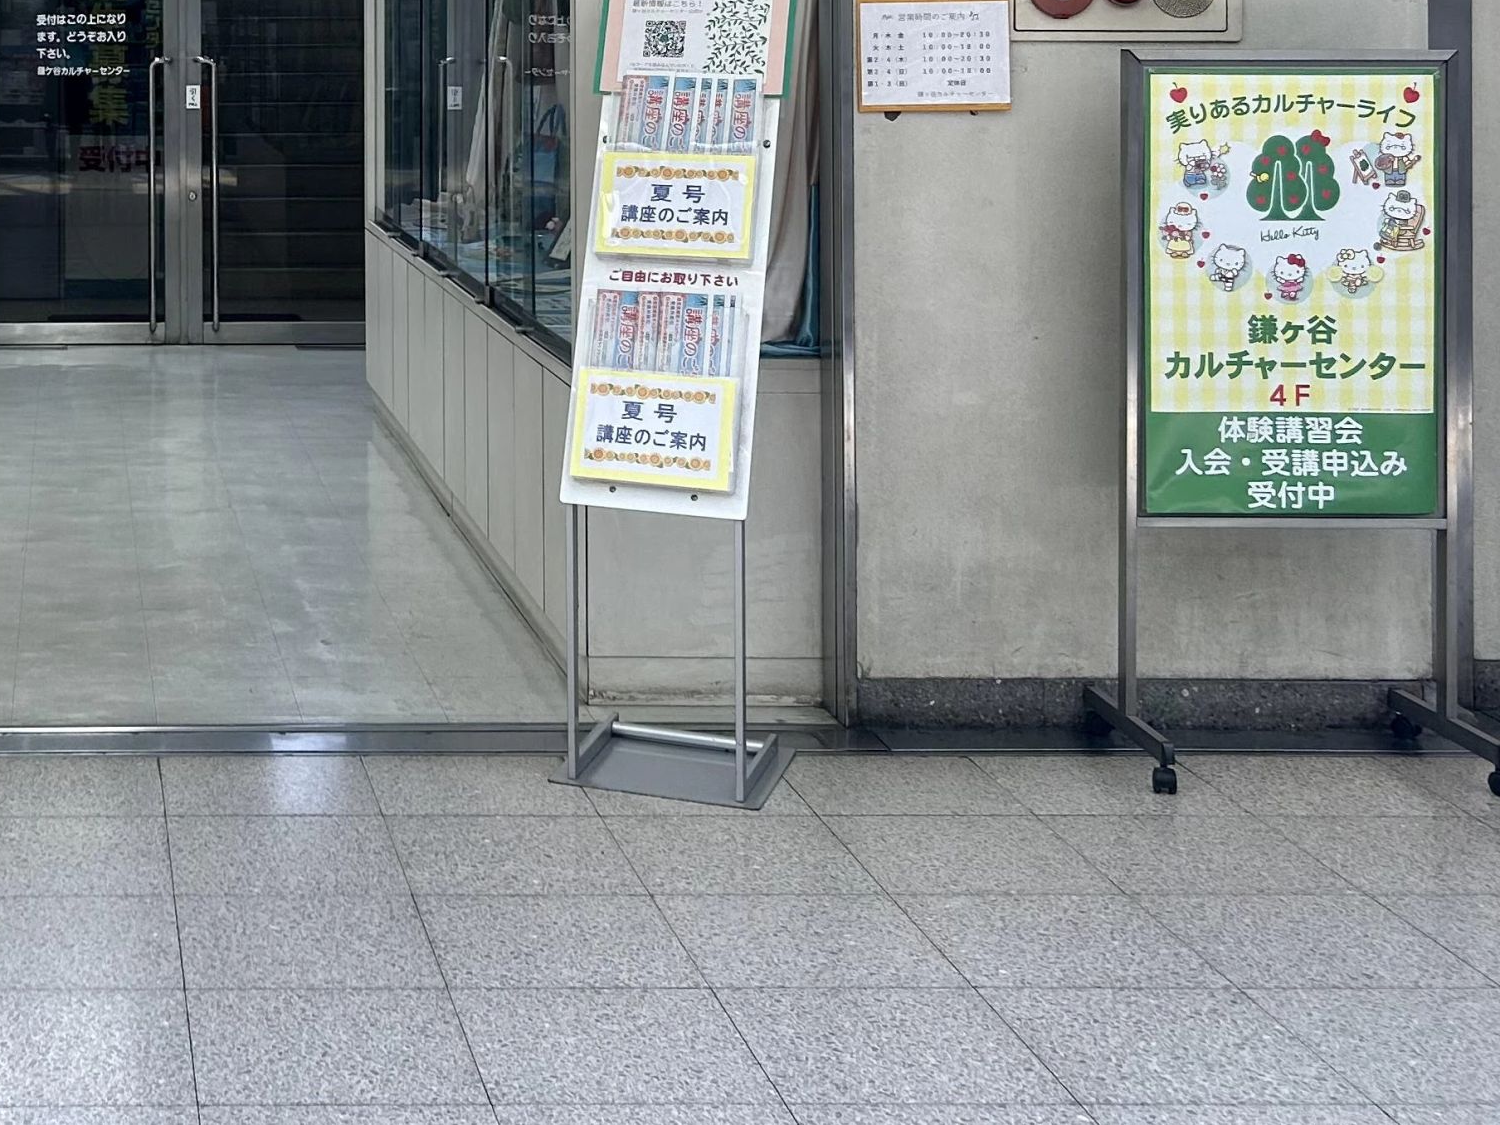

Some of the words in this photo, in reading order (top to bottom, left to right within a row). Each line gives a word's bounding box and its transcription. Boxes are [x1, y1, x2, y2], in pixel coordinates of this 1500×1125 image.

[36, 13, 126, 26] 受付はこの上になり
[36, 30, 126, 43] ます。どうぞお入り
[36, 48, 71, 60] 下さい。
[1165, 93, 1416, 134] 実りあるカルチャーライフ
[620, 205, 729, 226] 講座のご案内
[1260, 228, 1290, 242] Hello
[1292, 226, 1319, 241] Kitty
[608, 269, 739, 287] ご自由にお取り下さい
[1164, 350, 1426, 380] カルチャーセンター
[1269, 384, 1311, 407] 4F
[596, 424, 707, 452] 講座のご案内
[1217, 416, 1364, 445] 体験講習会
[1175, 448, 1408, 477] 入会・受講申込み
[1247, 481, 1336, 510] 受付中
